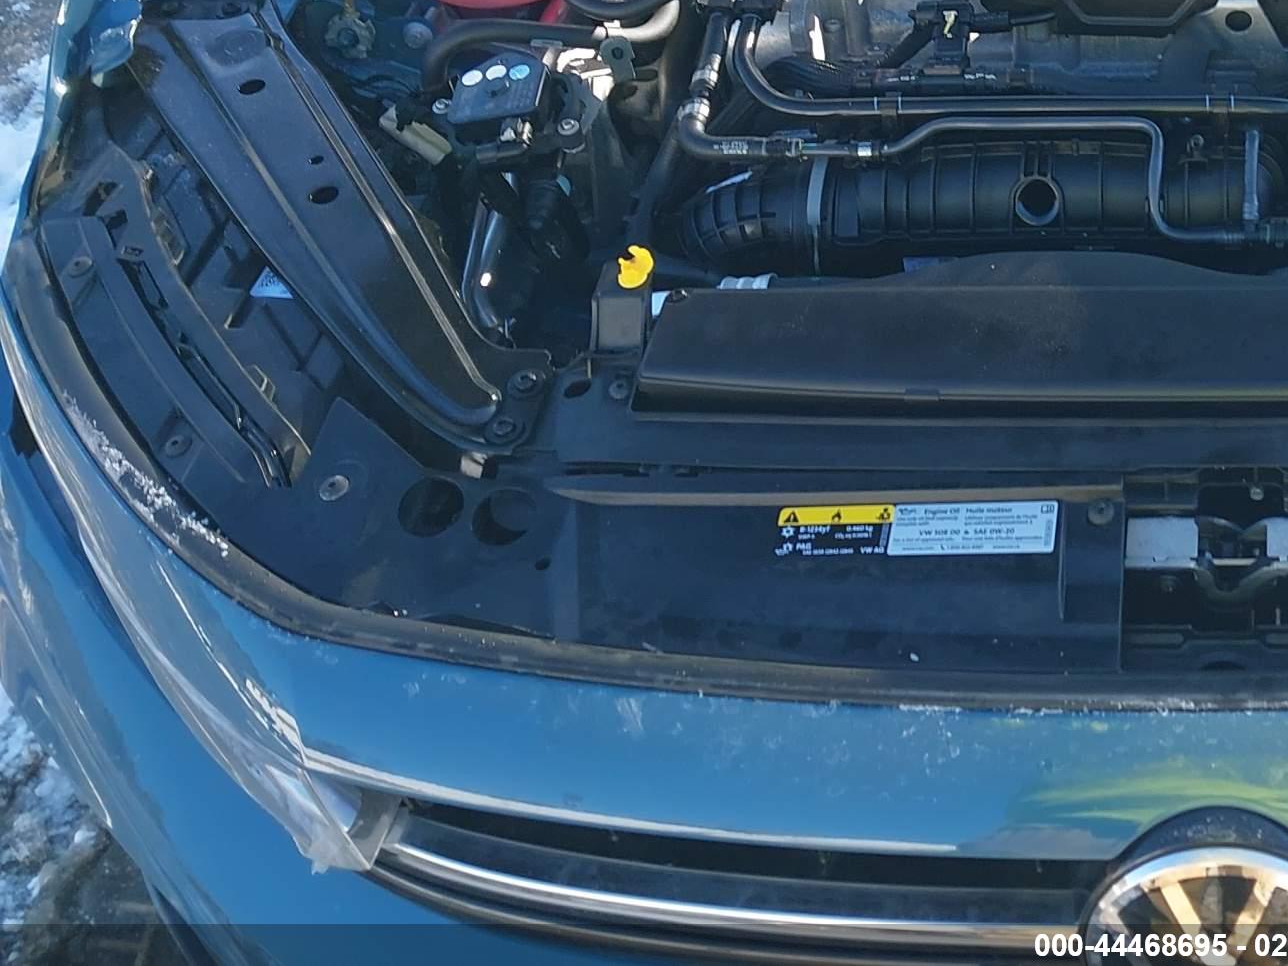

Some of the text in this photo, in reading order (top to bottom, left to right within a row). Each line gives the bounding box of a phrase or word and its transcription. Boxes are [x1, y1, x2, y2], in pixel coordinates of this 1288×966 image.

[924, 508, 948, 517] Engine
[919, 529, 933, 537] VW
[860, 545, 873, 554] VW
[873, 545, 885, 554] AG
